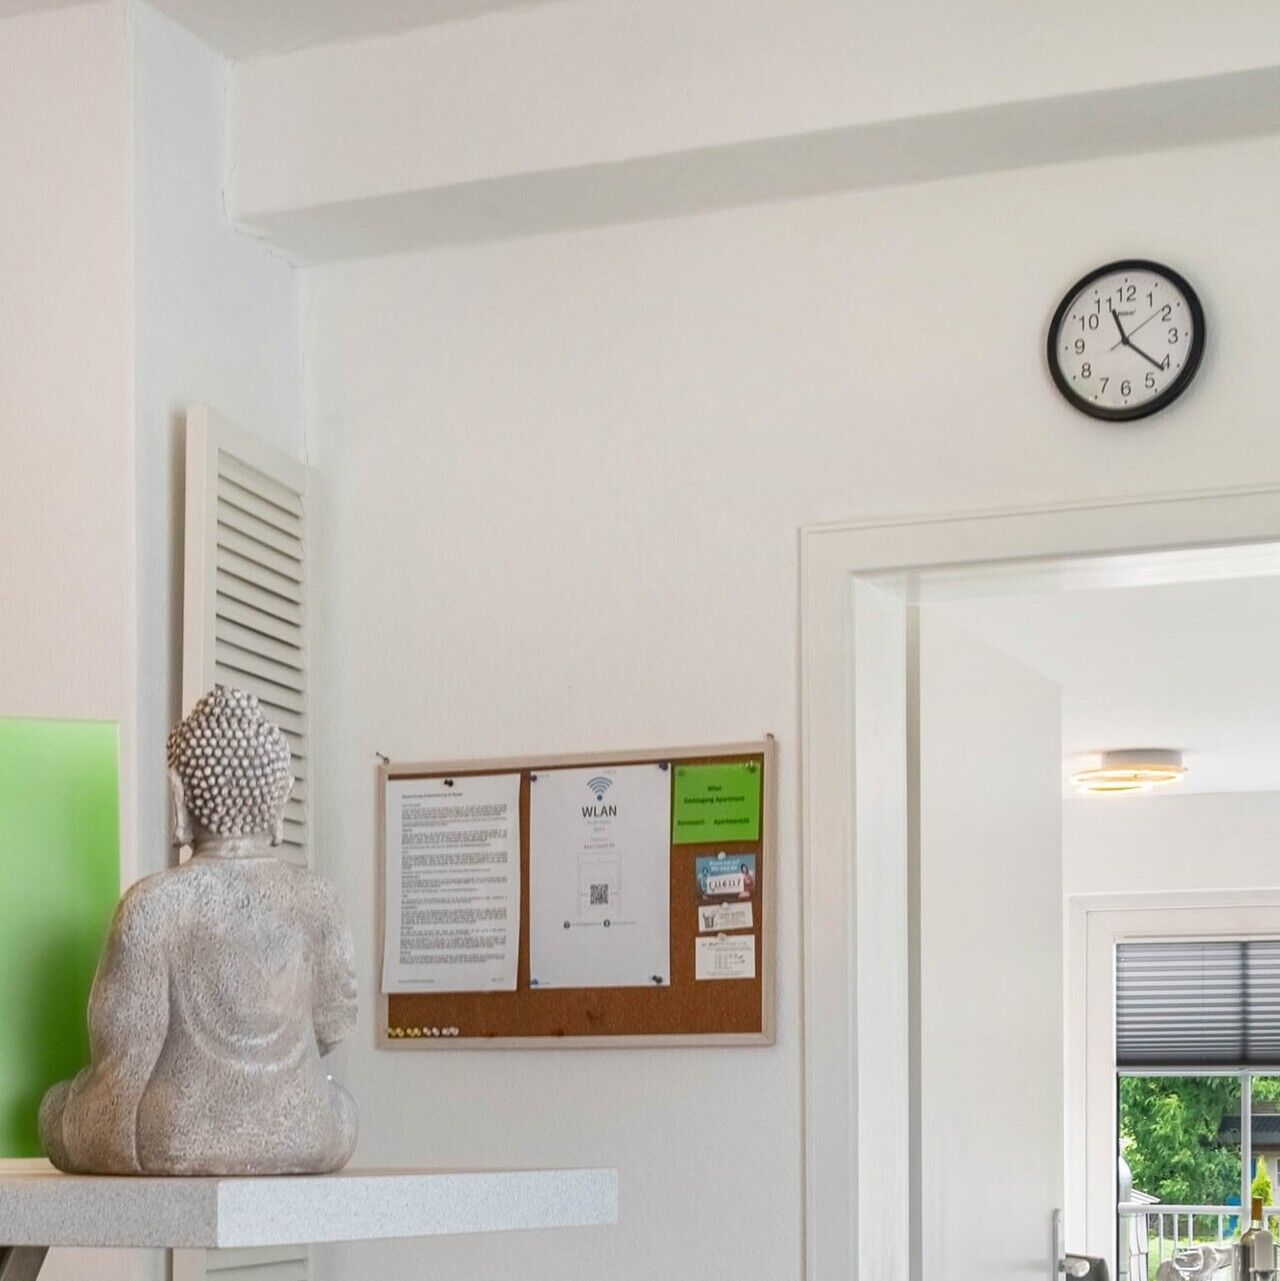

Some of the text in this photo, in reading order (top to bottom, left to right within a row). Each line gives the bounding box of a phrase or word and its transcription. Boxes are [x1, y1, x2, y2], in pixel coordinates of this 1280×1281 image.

[1116, 285, 1137, 302] 12
[1146, 291, 1153, 308] 1
[1094, 297, 1113, 314] 11
[1161, 304, 1172, 322] 2
[1079, 314, 1099, 331] 10
[1167, 327, 1179, 344] 3
[1074, 338, 1085, 355] 9
[1160, 353, 1170, 369] 4
[1081, 362, 1092, 379] 8
[1100, 377, 1109, 393] 7
[1120, 380, 1131, 397] 6
[1145, 372, 1155, 388] 5
[581, 804, 618, 819] WLAN
